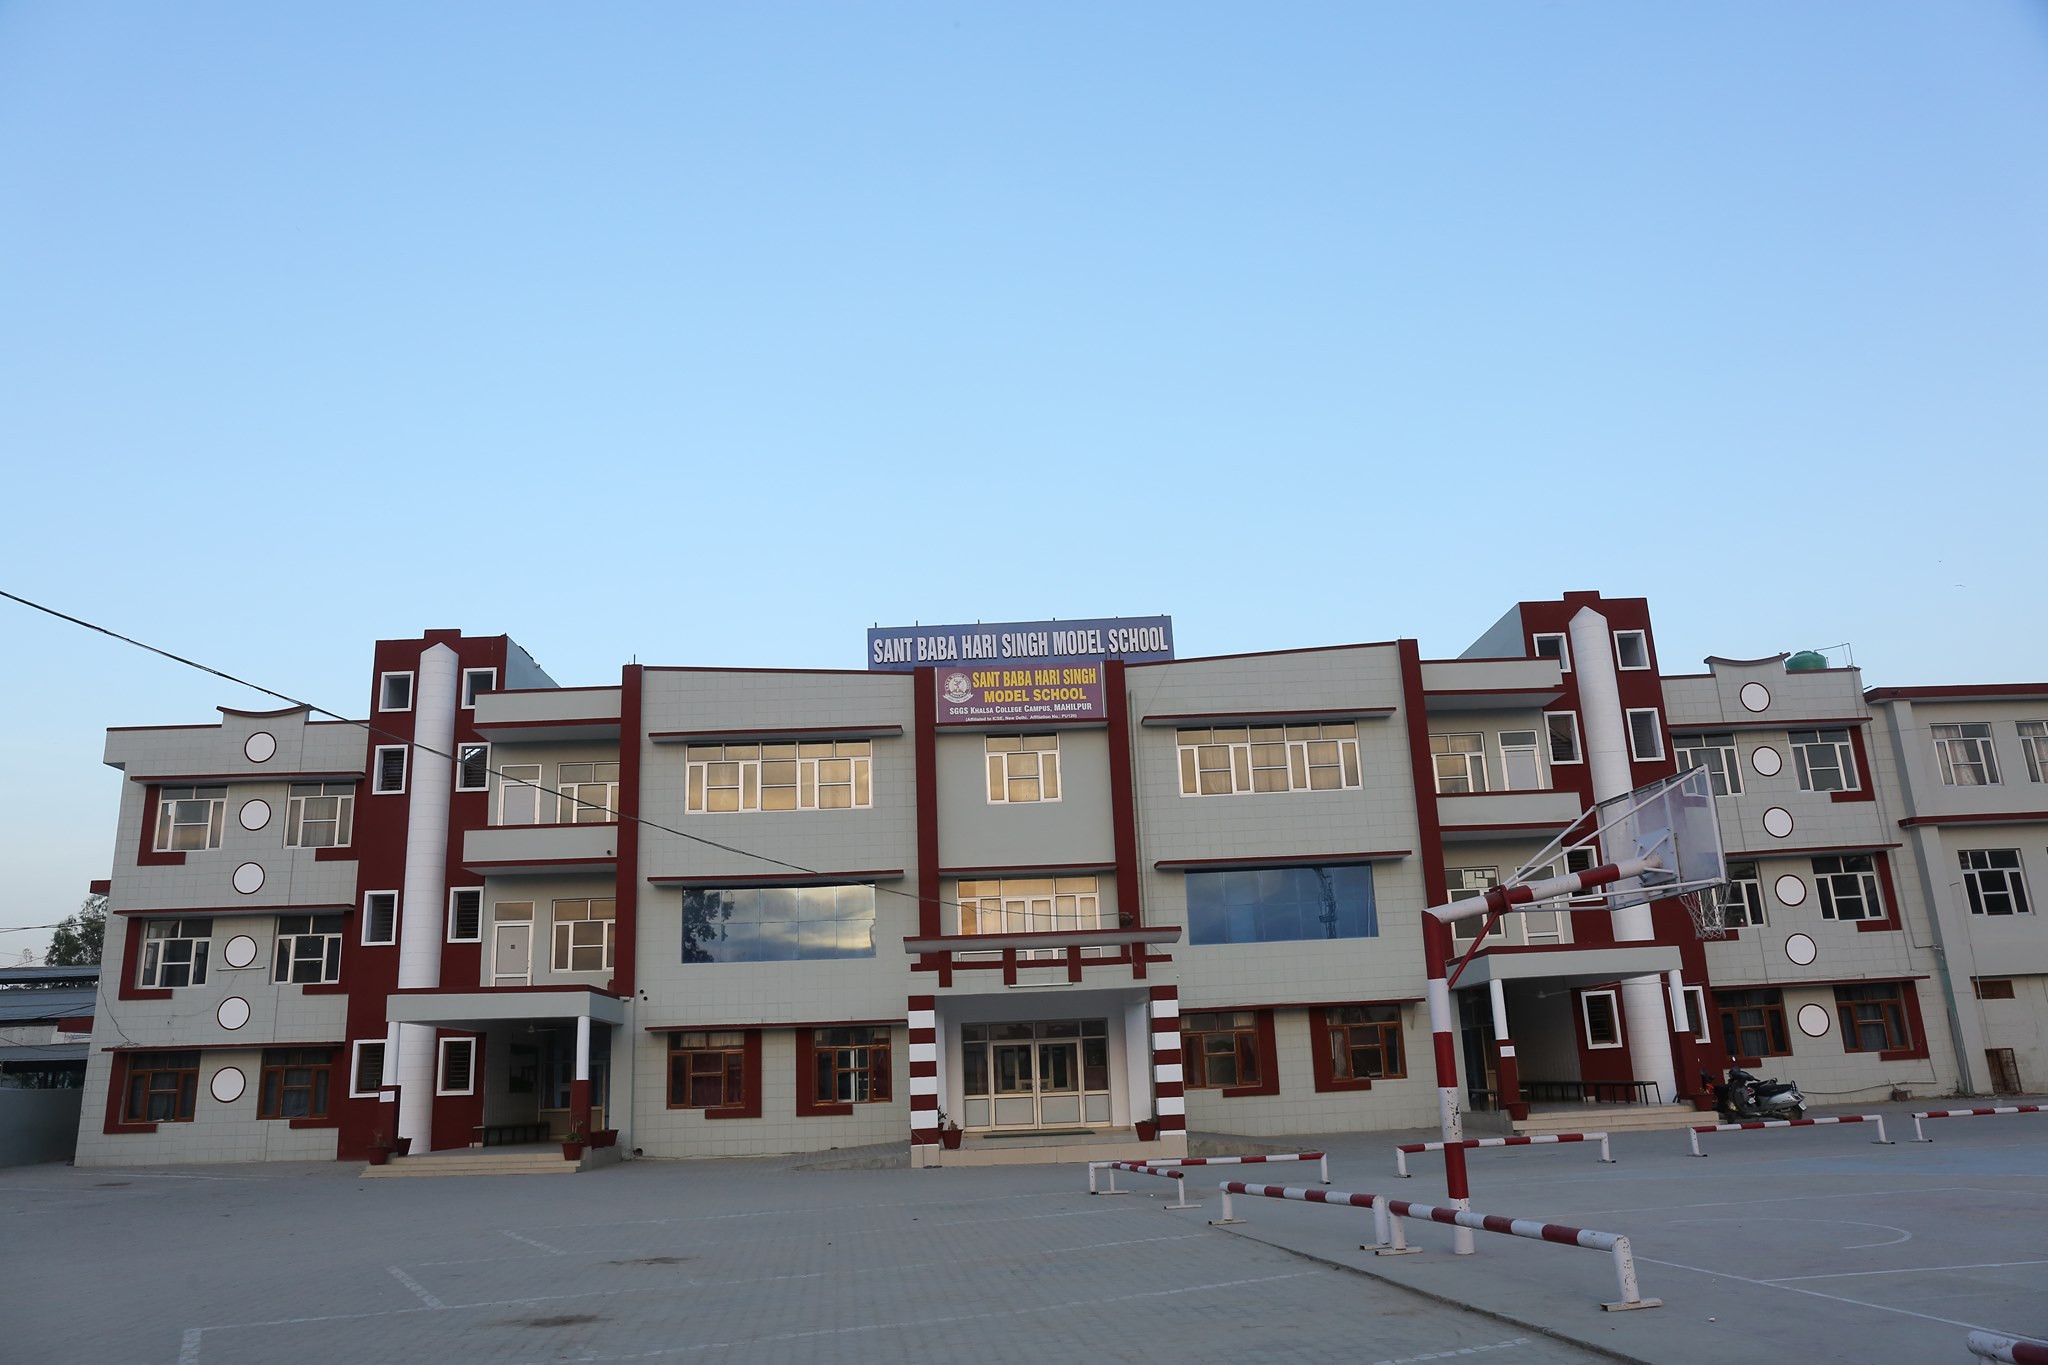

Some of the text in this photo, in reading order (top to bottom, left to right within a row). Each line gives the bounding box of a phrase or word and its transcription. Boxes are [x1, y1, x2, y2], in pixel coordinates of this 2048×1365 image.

[873, 626, 1168, 664] SANT BABA HARI SINGH MODEL SCHOOL
[972, 671, 1000, 688] SANT
[1003, 670, 1032, 687] BABA
[1035, 669, 1060, 685] HARI
[1063, 668, 1096, 684] SINGH
[984, 690, 1030, 703] MODEL
[1033, 687, 1087, 701] SCHOOL
[949, 707, 969, 715] SGGS
[1053, 703, 1092, 711] MAHILPUR
